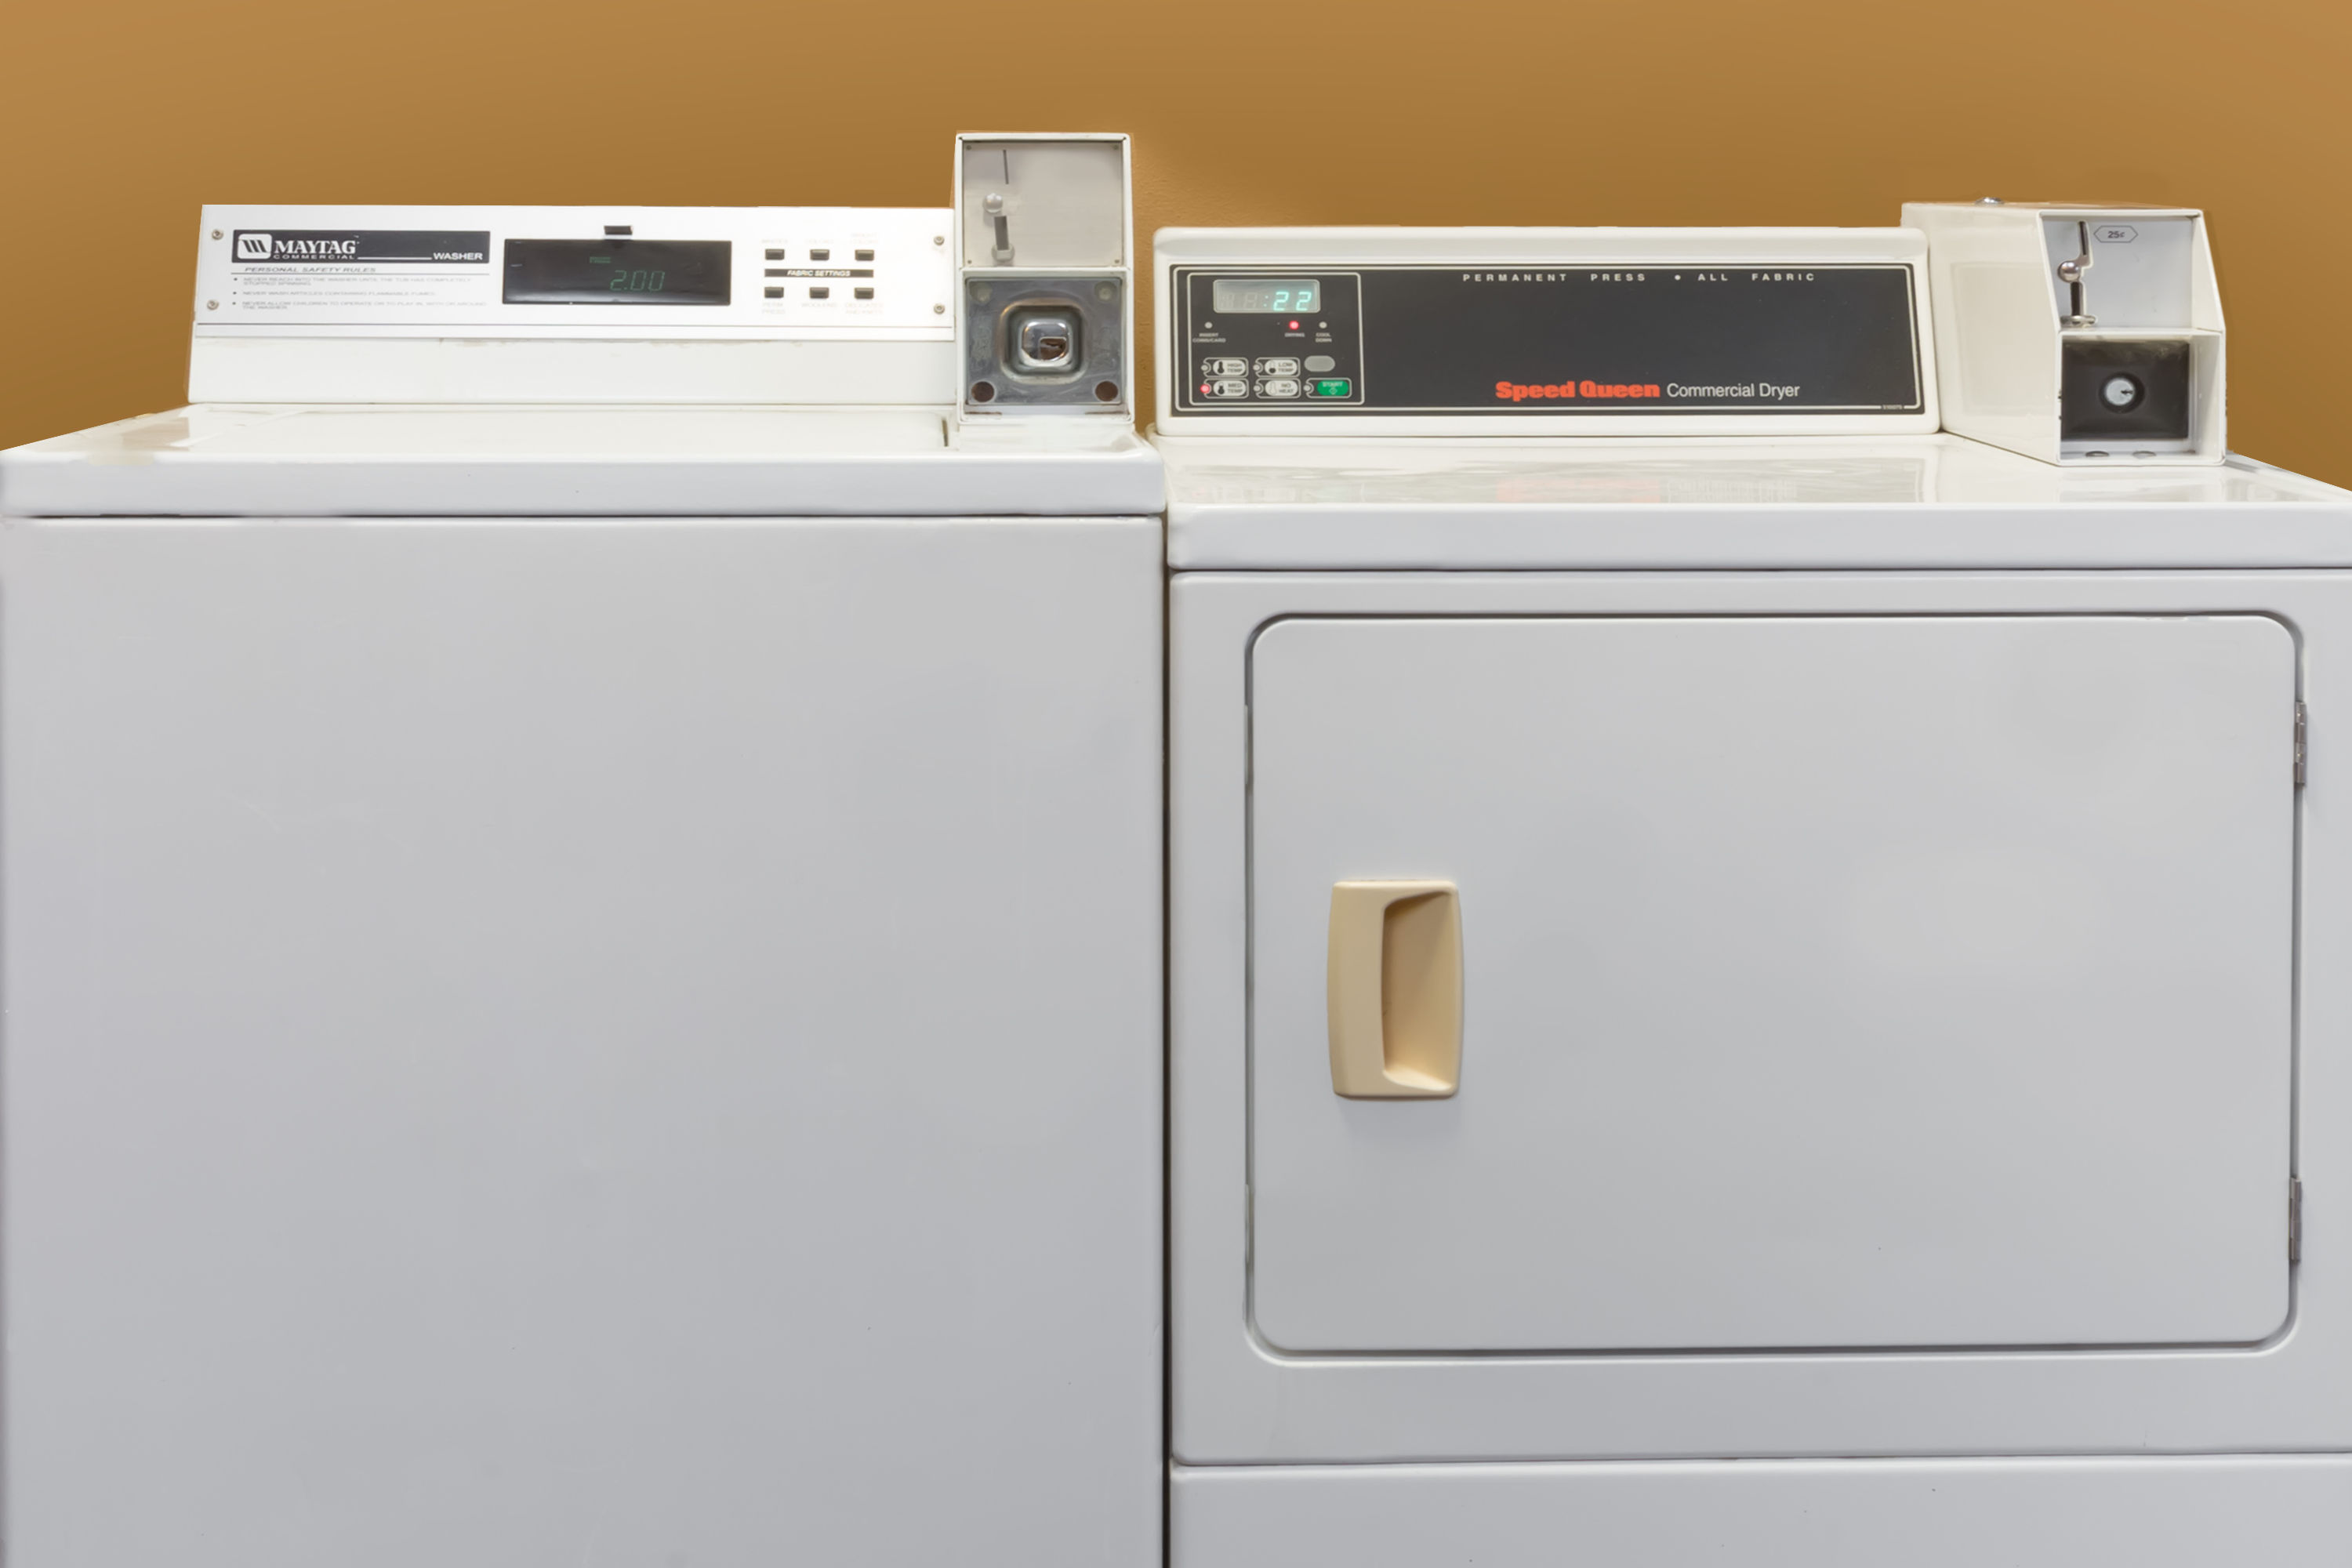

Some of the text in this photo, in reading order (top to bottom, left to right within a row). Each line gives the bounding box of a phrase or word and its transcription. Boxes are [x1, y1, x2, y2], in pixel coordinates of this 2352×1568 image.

[274, 240, 356, 254] MAYTAG
[610, 270, 666, 291] 2.00
[1462, 273, 1814, 281] PERMANENT PRESS ALL FABRIC
[1495, 380, 1801, 401] Speed Queen Commercial Dryer
